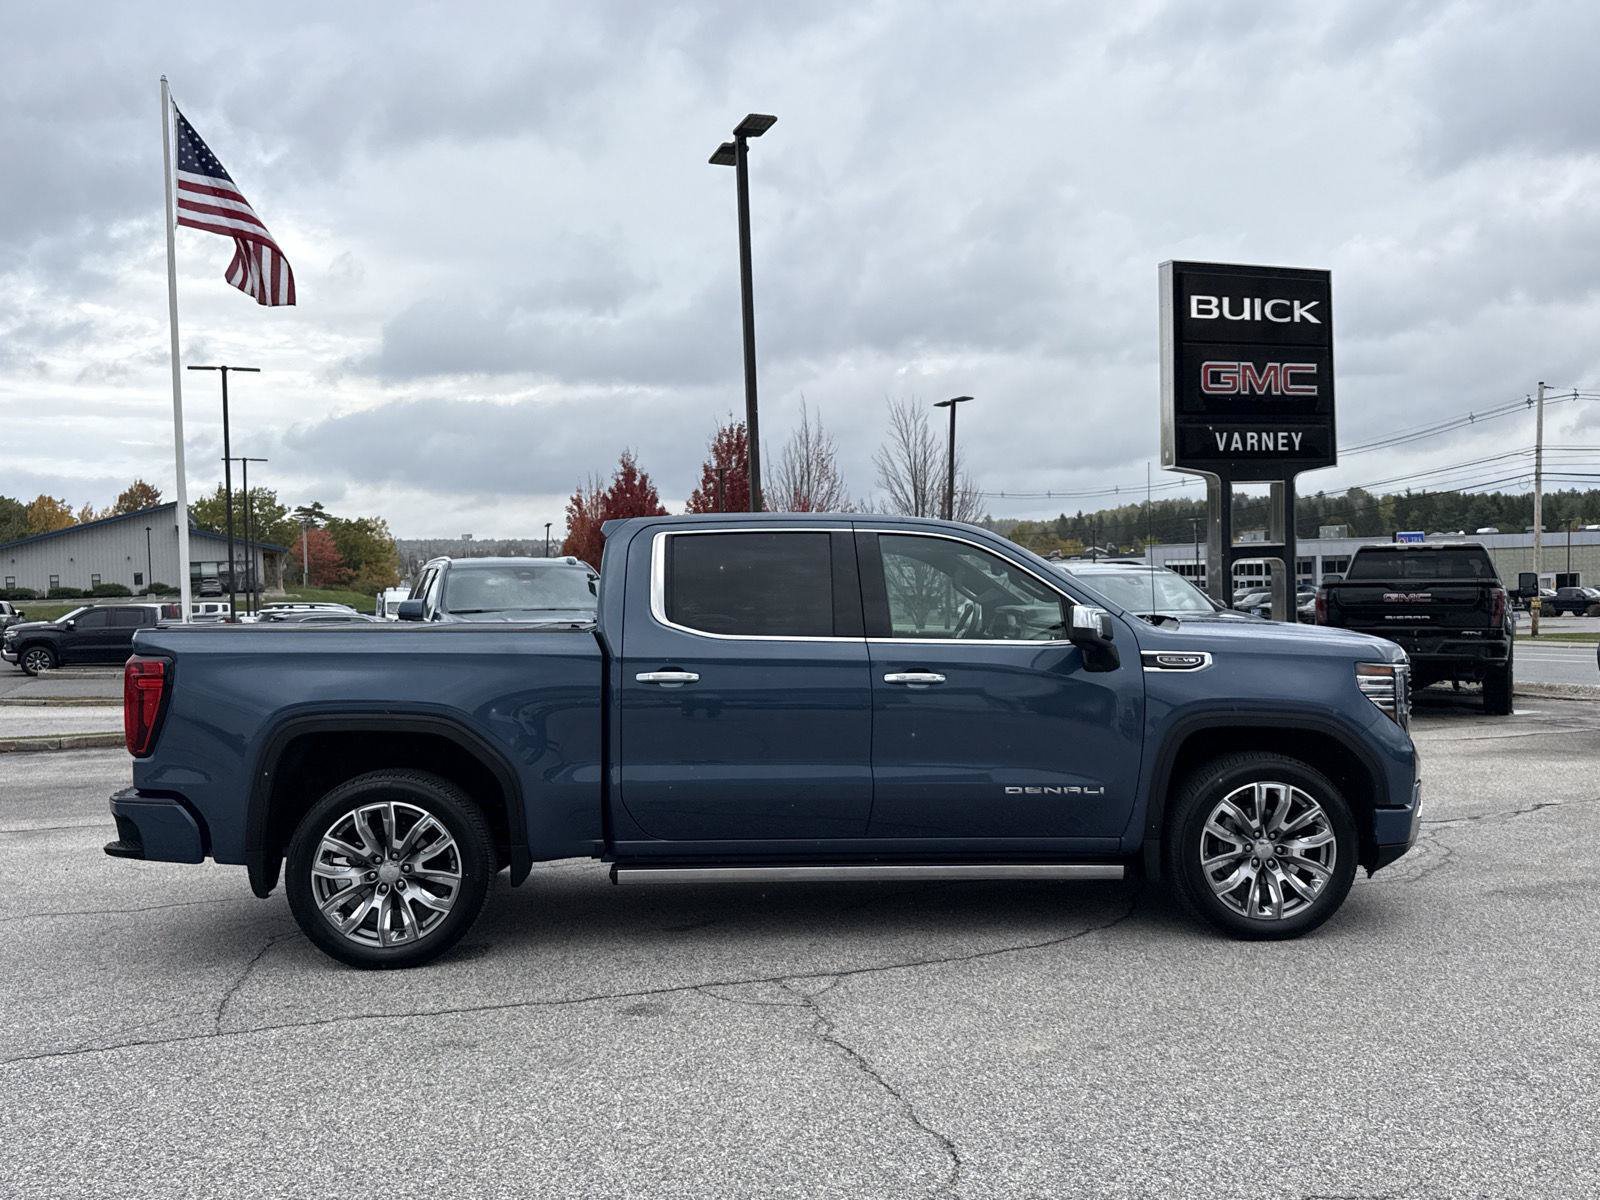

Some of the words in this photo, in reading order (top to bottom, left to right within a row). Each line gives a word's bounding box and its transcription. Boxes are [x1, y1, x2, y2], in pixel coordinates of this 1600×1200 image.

[1190, 295, 1321, 323] BUICK
[1201, 361, 1317, 395] GMC
[1215, 431, 1302, 451] VARNEY
[1383, 593, 1431, 602] GMC
[1005, 786, 1105, 794] DENALI
